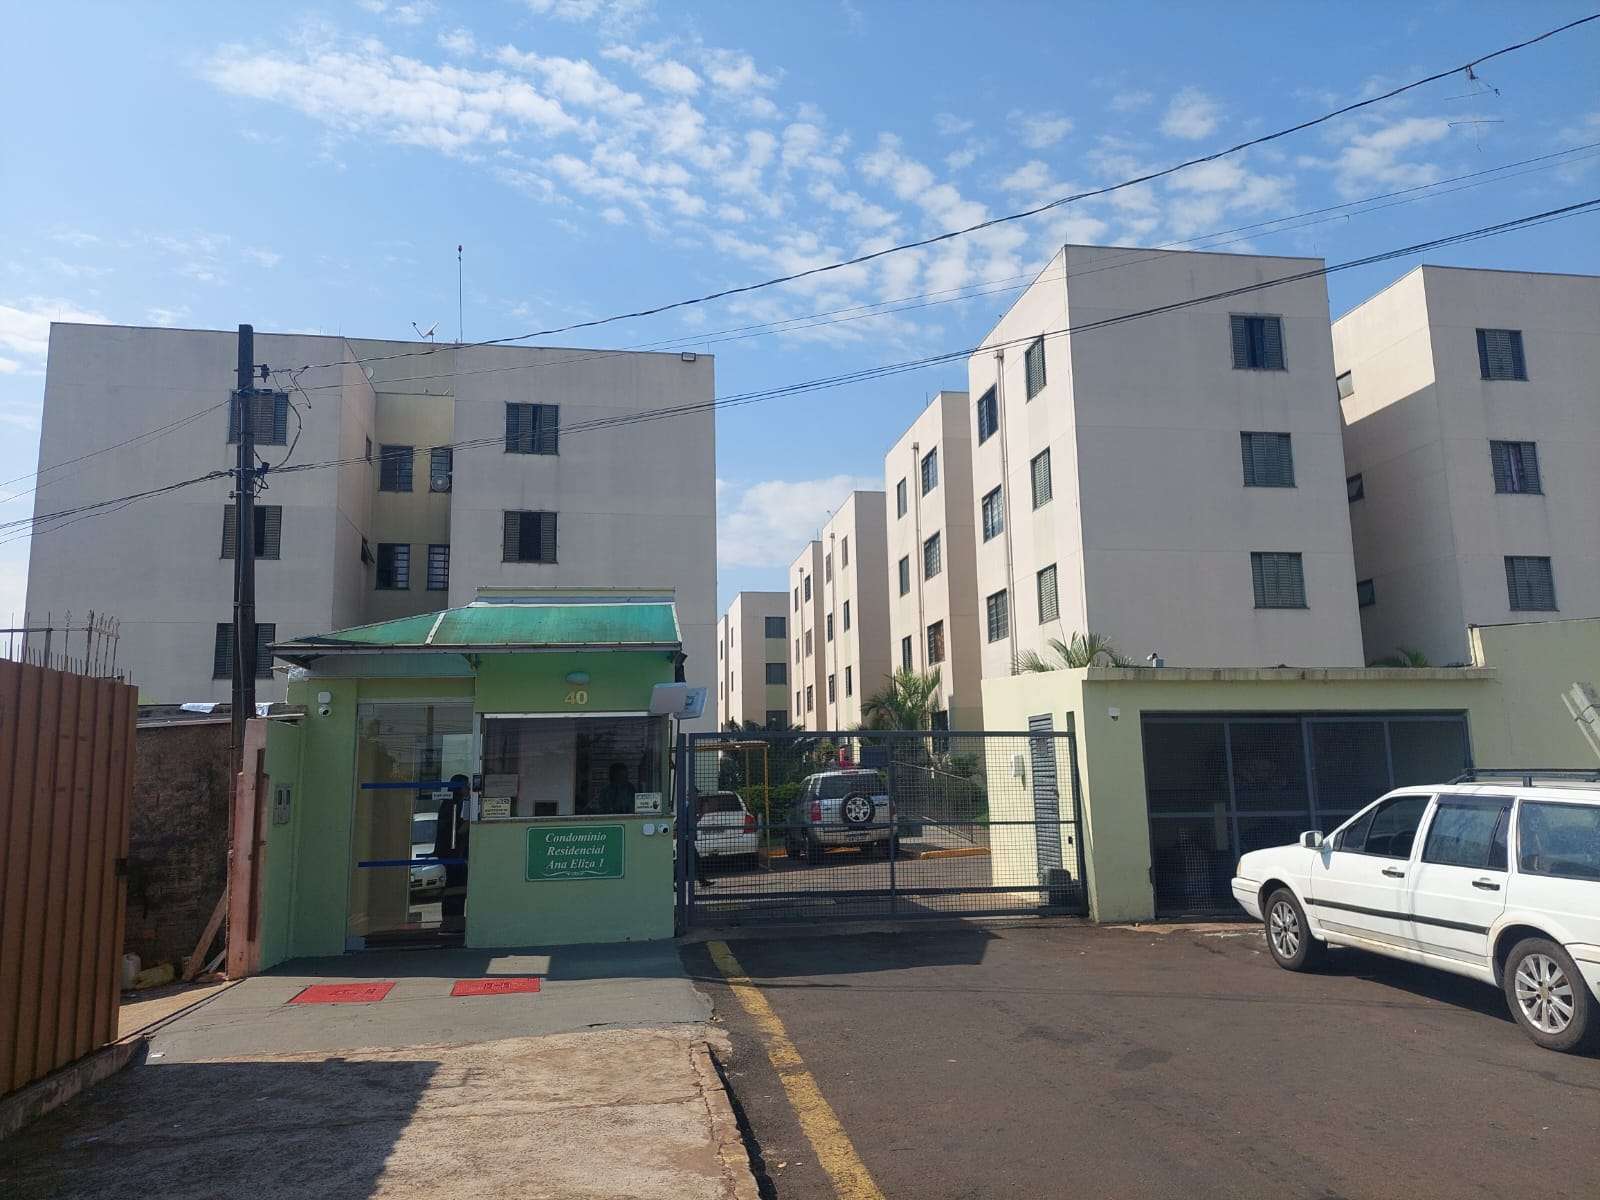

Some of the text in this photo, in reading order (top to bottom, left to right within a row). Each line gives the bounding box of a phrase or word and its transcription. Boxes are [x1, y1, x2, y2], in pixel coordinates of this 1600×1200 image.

[564, 690, 588, 705] 40
[546, 832, 606, 843] Condominio
[547, 845, 604, 856] Residencial
[546, 860, 568, 870] Ana
[570, 859, 595, 870] Eliza
